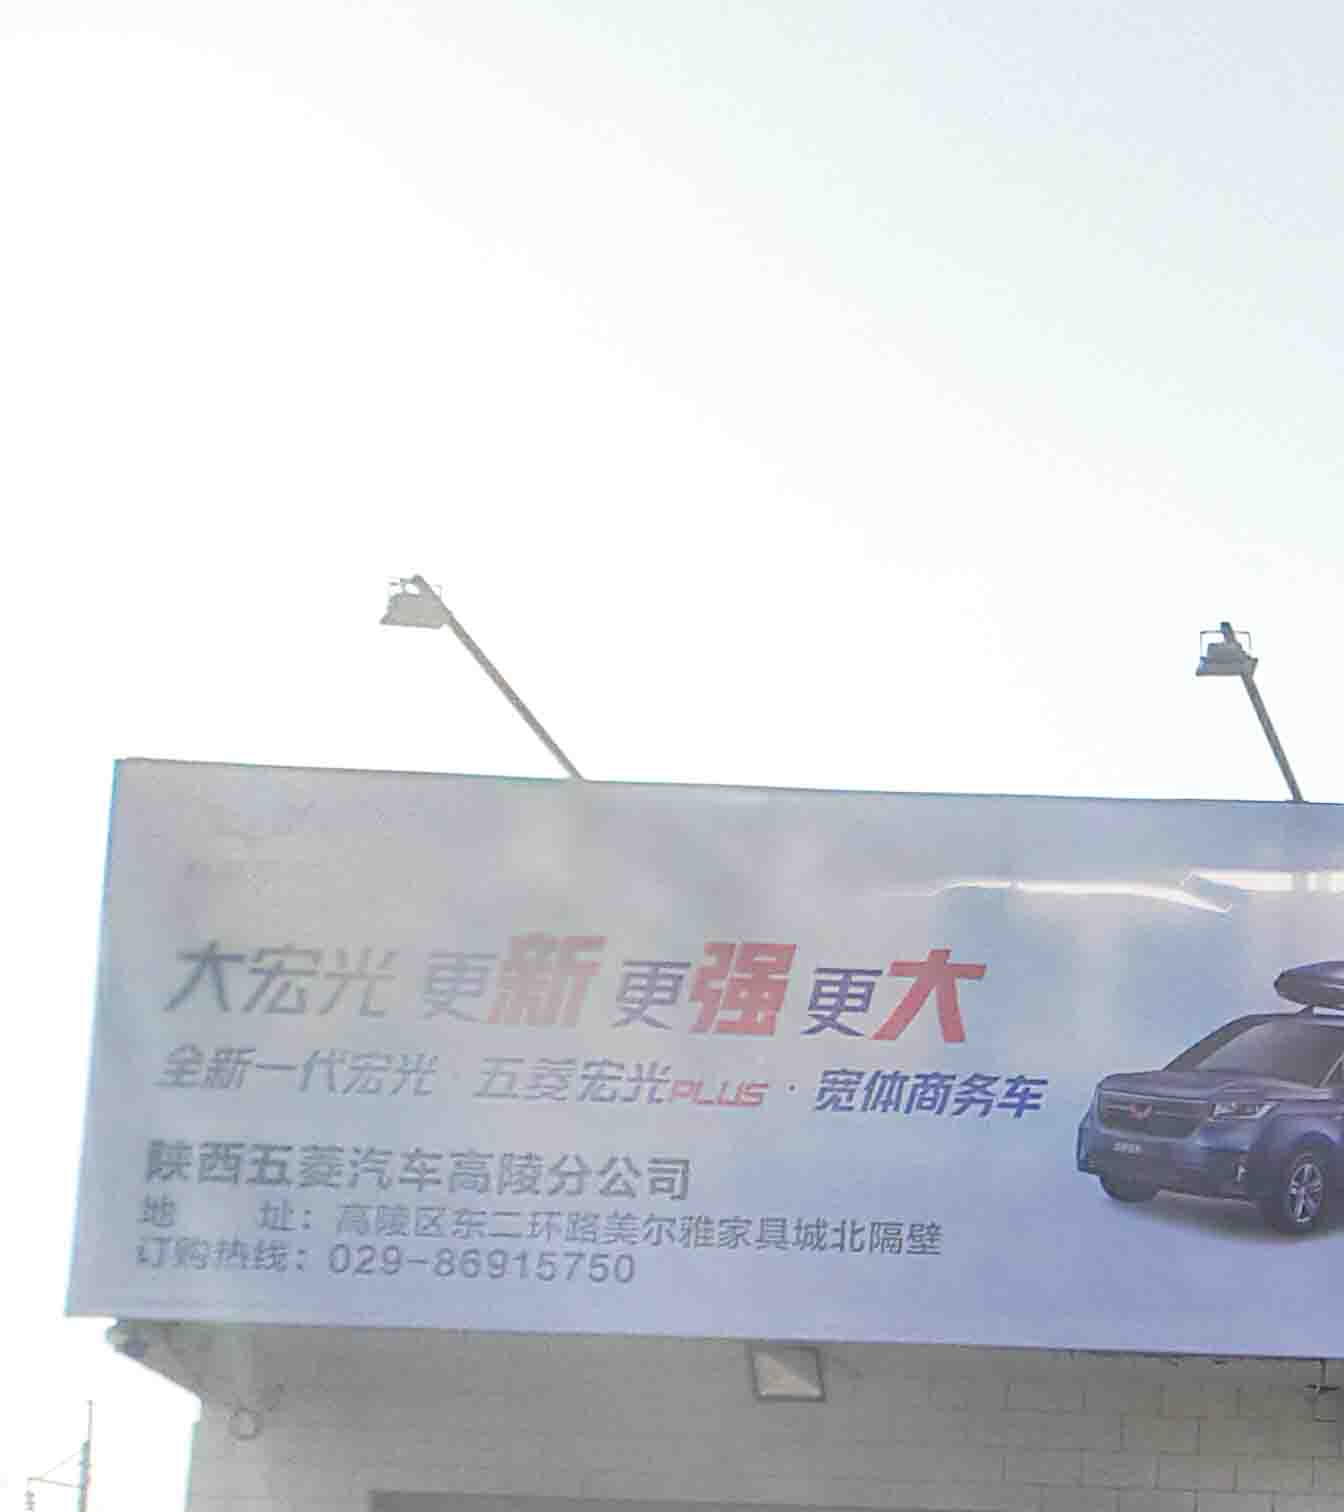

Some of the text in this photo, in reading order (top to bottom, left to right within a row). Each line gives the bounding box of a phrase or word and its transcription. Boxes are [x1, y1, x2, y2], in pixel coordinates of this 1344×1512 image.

[154, 1042, 438, 1098] 全新一代宏光
[143, 1138, 690, 1201] 陕西五菱汽车高陵分公司
